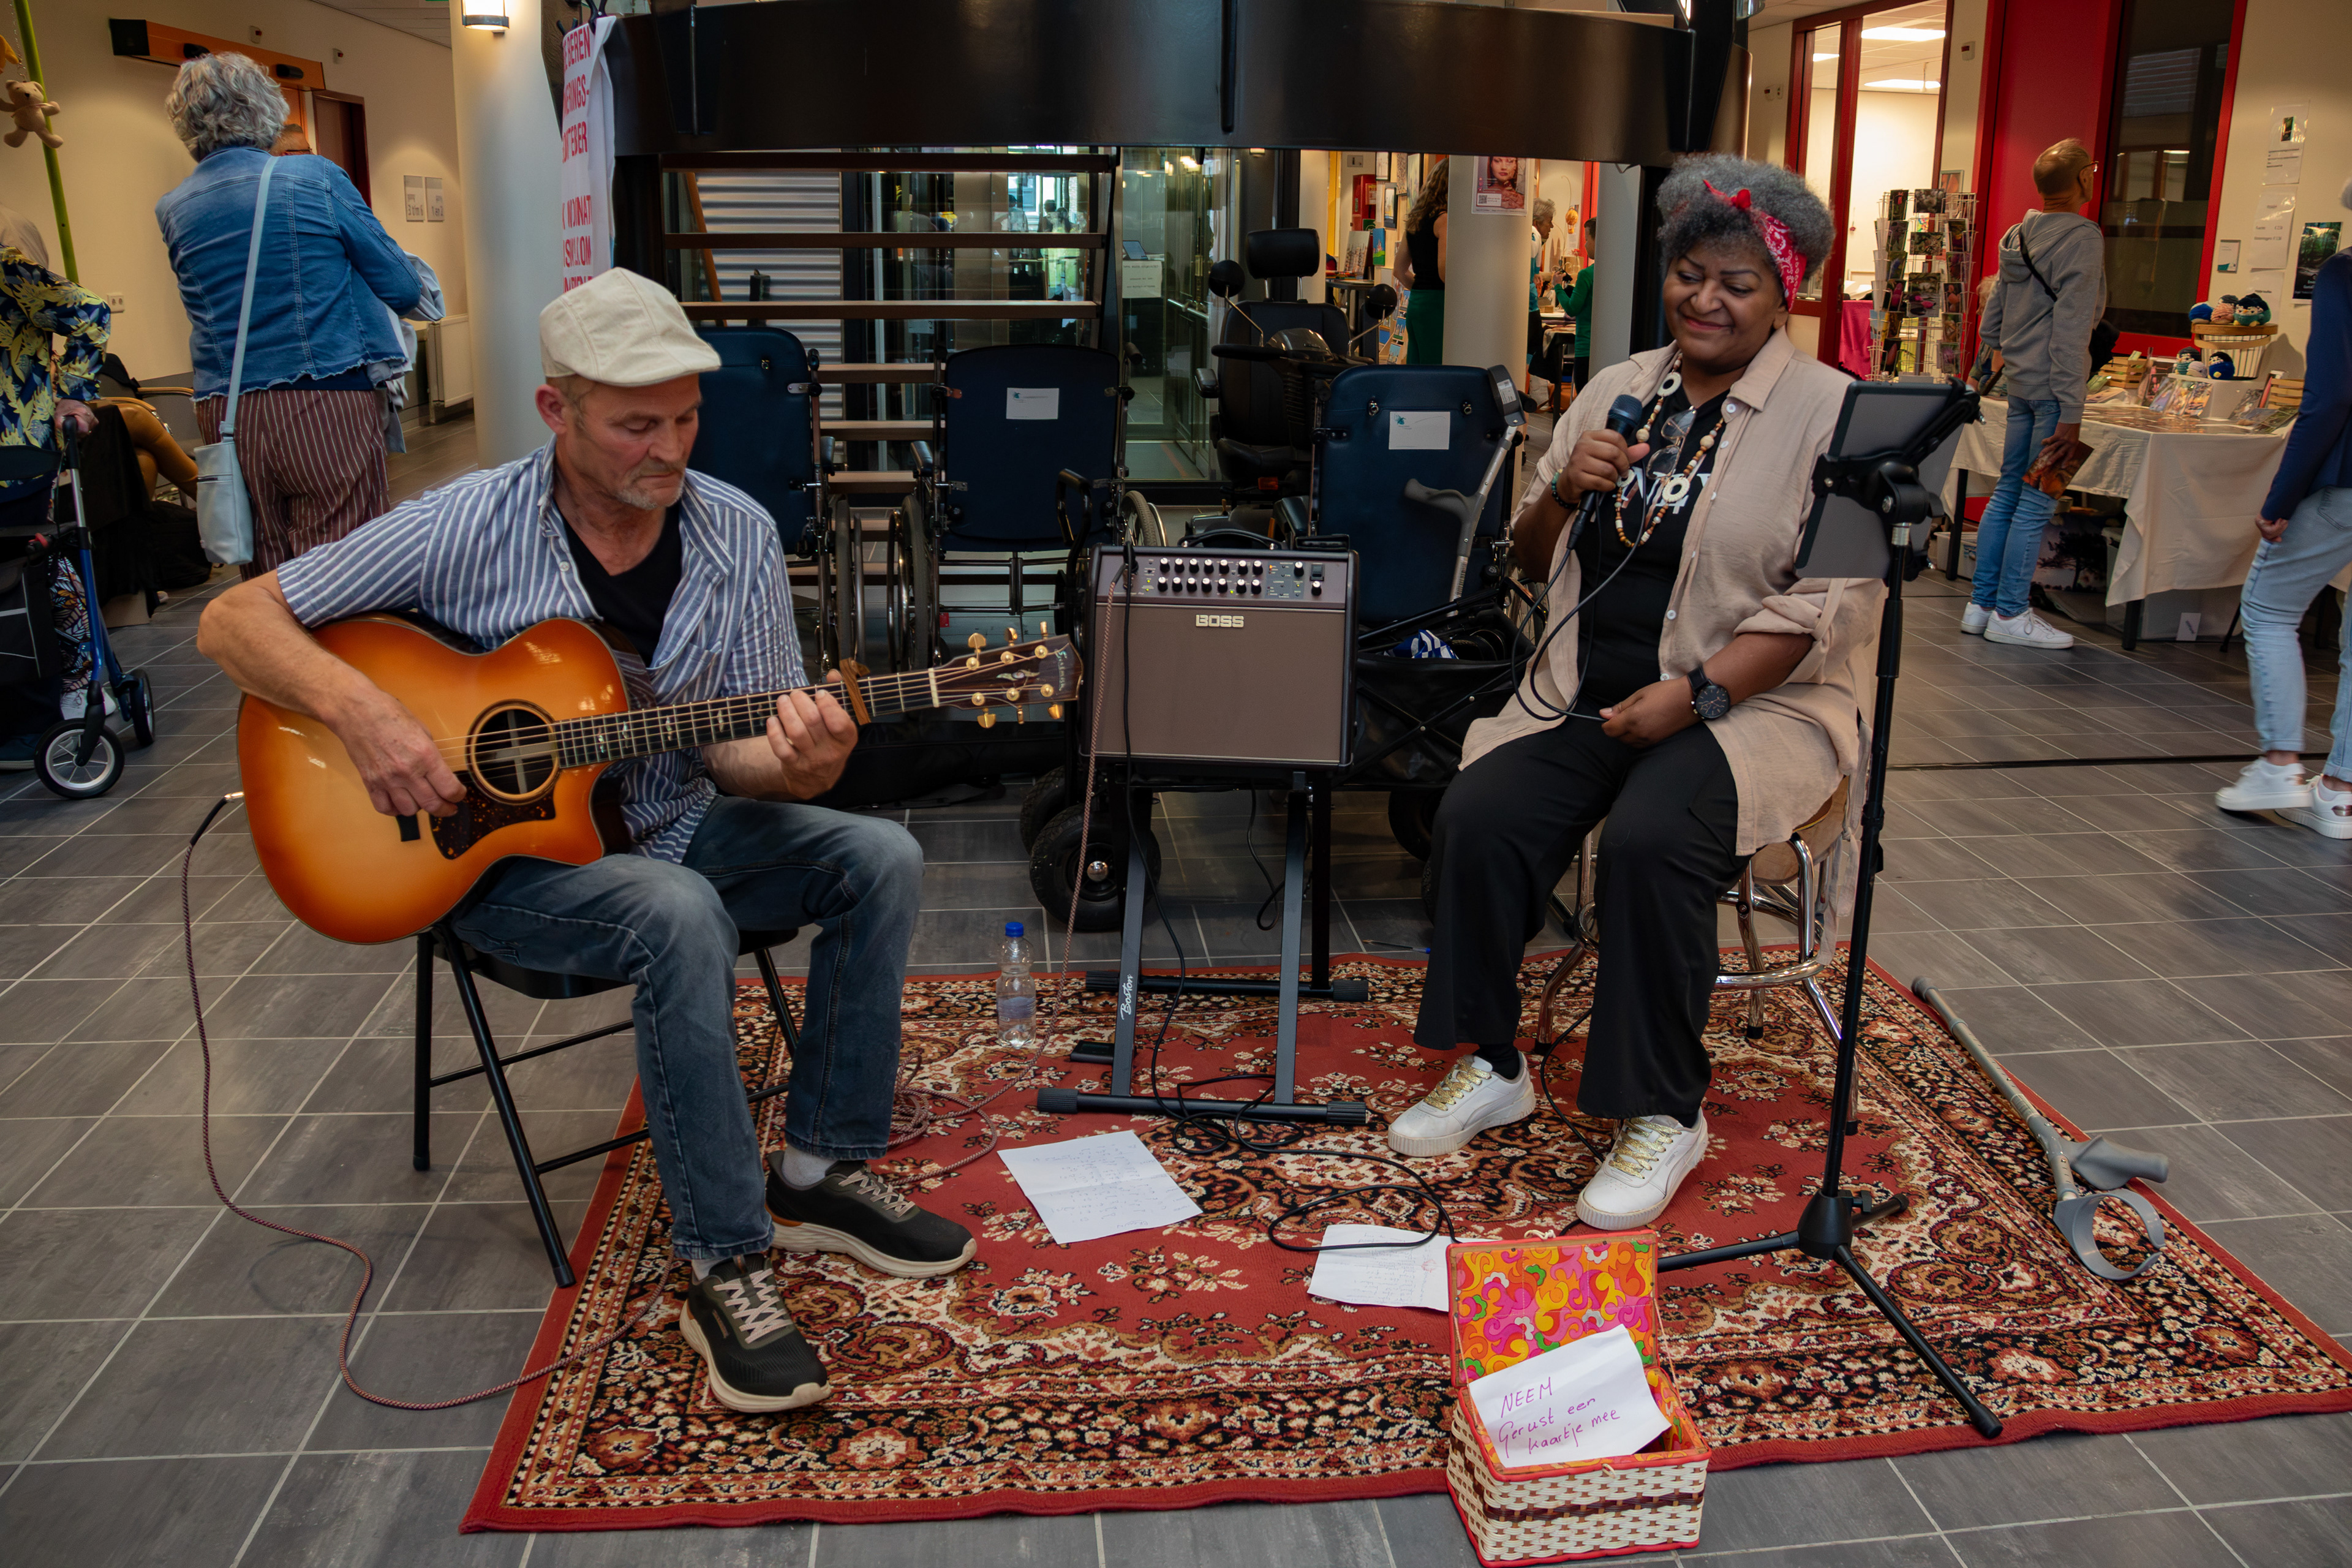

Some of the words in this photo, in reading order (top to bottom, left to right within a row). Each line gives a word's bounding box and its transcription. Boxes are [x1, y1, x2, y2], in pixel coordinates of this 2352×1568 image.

[1196, 614, 1244, 628] BOSS
[1120, 974, 1133, 1020] Boston
[1501, 1376, 1552, 1419] NEEM
[1499, 1408, 1555, 1458] Gerust
[1528, 1423, 1583, 1455] kaartje
[1591, 1409, 1621, 1428] mee
